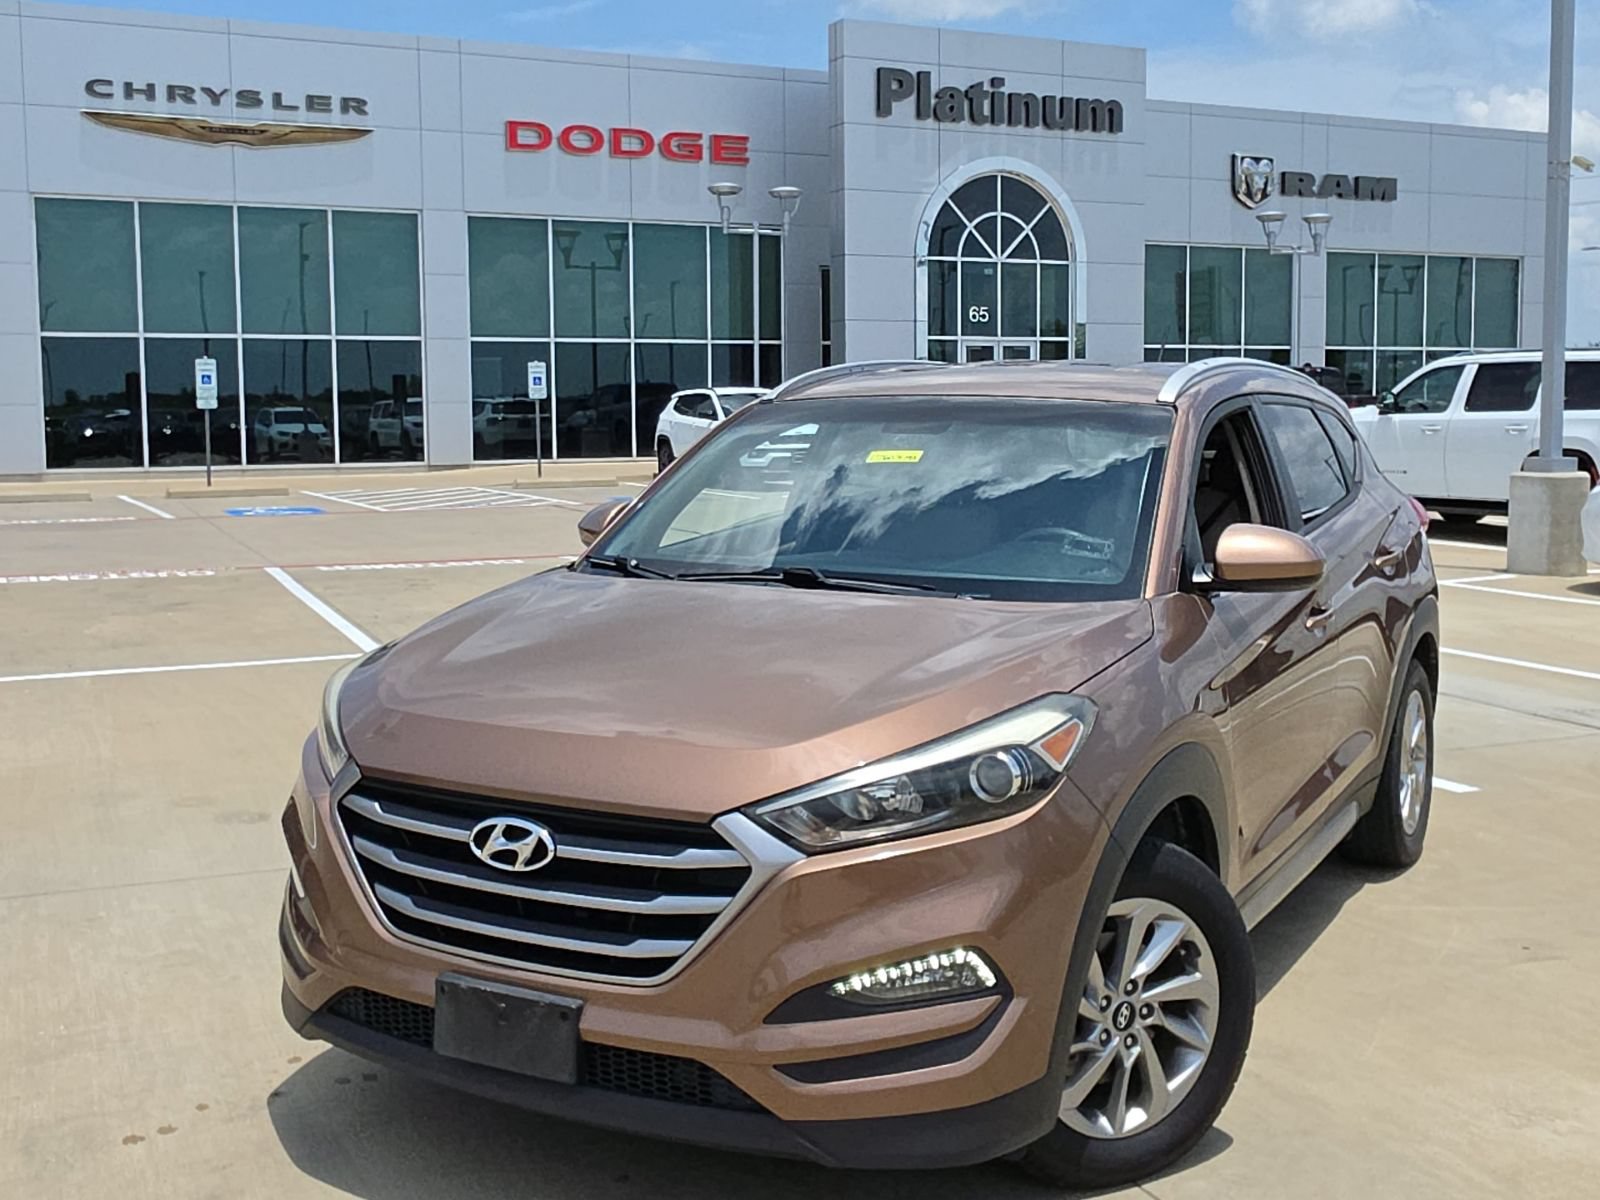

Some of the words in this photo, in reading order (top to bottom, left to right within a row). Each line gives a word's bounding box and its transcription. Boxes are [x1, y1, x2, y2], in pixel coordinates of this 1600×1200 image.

[85, 78, 369, 116] CHRYSLER
[876, 66, 1124, 134] Platinum
[505, 120, 750, 167] DODGE
[1280, 171, 1398, 203] RAM
[968, 305, 990, 323] 65
